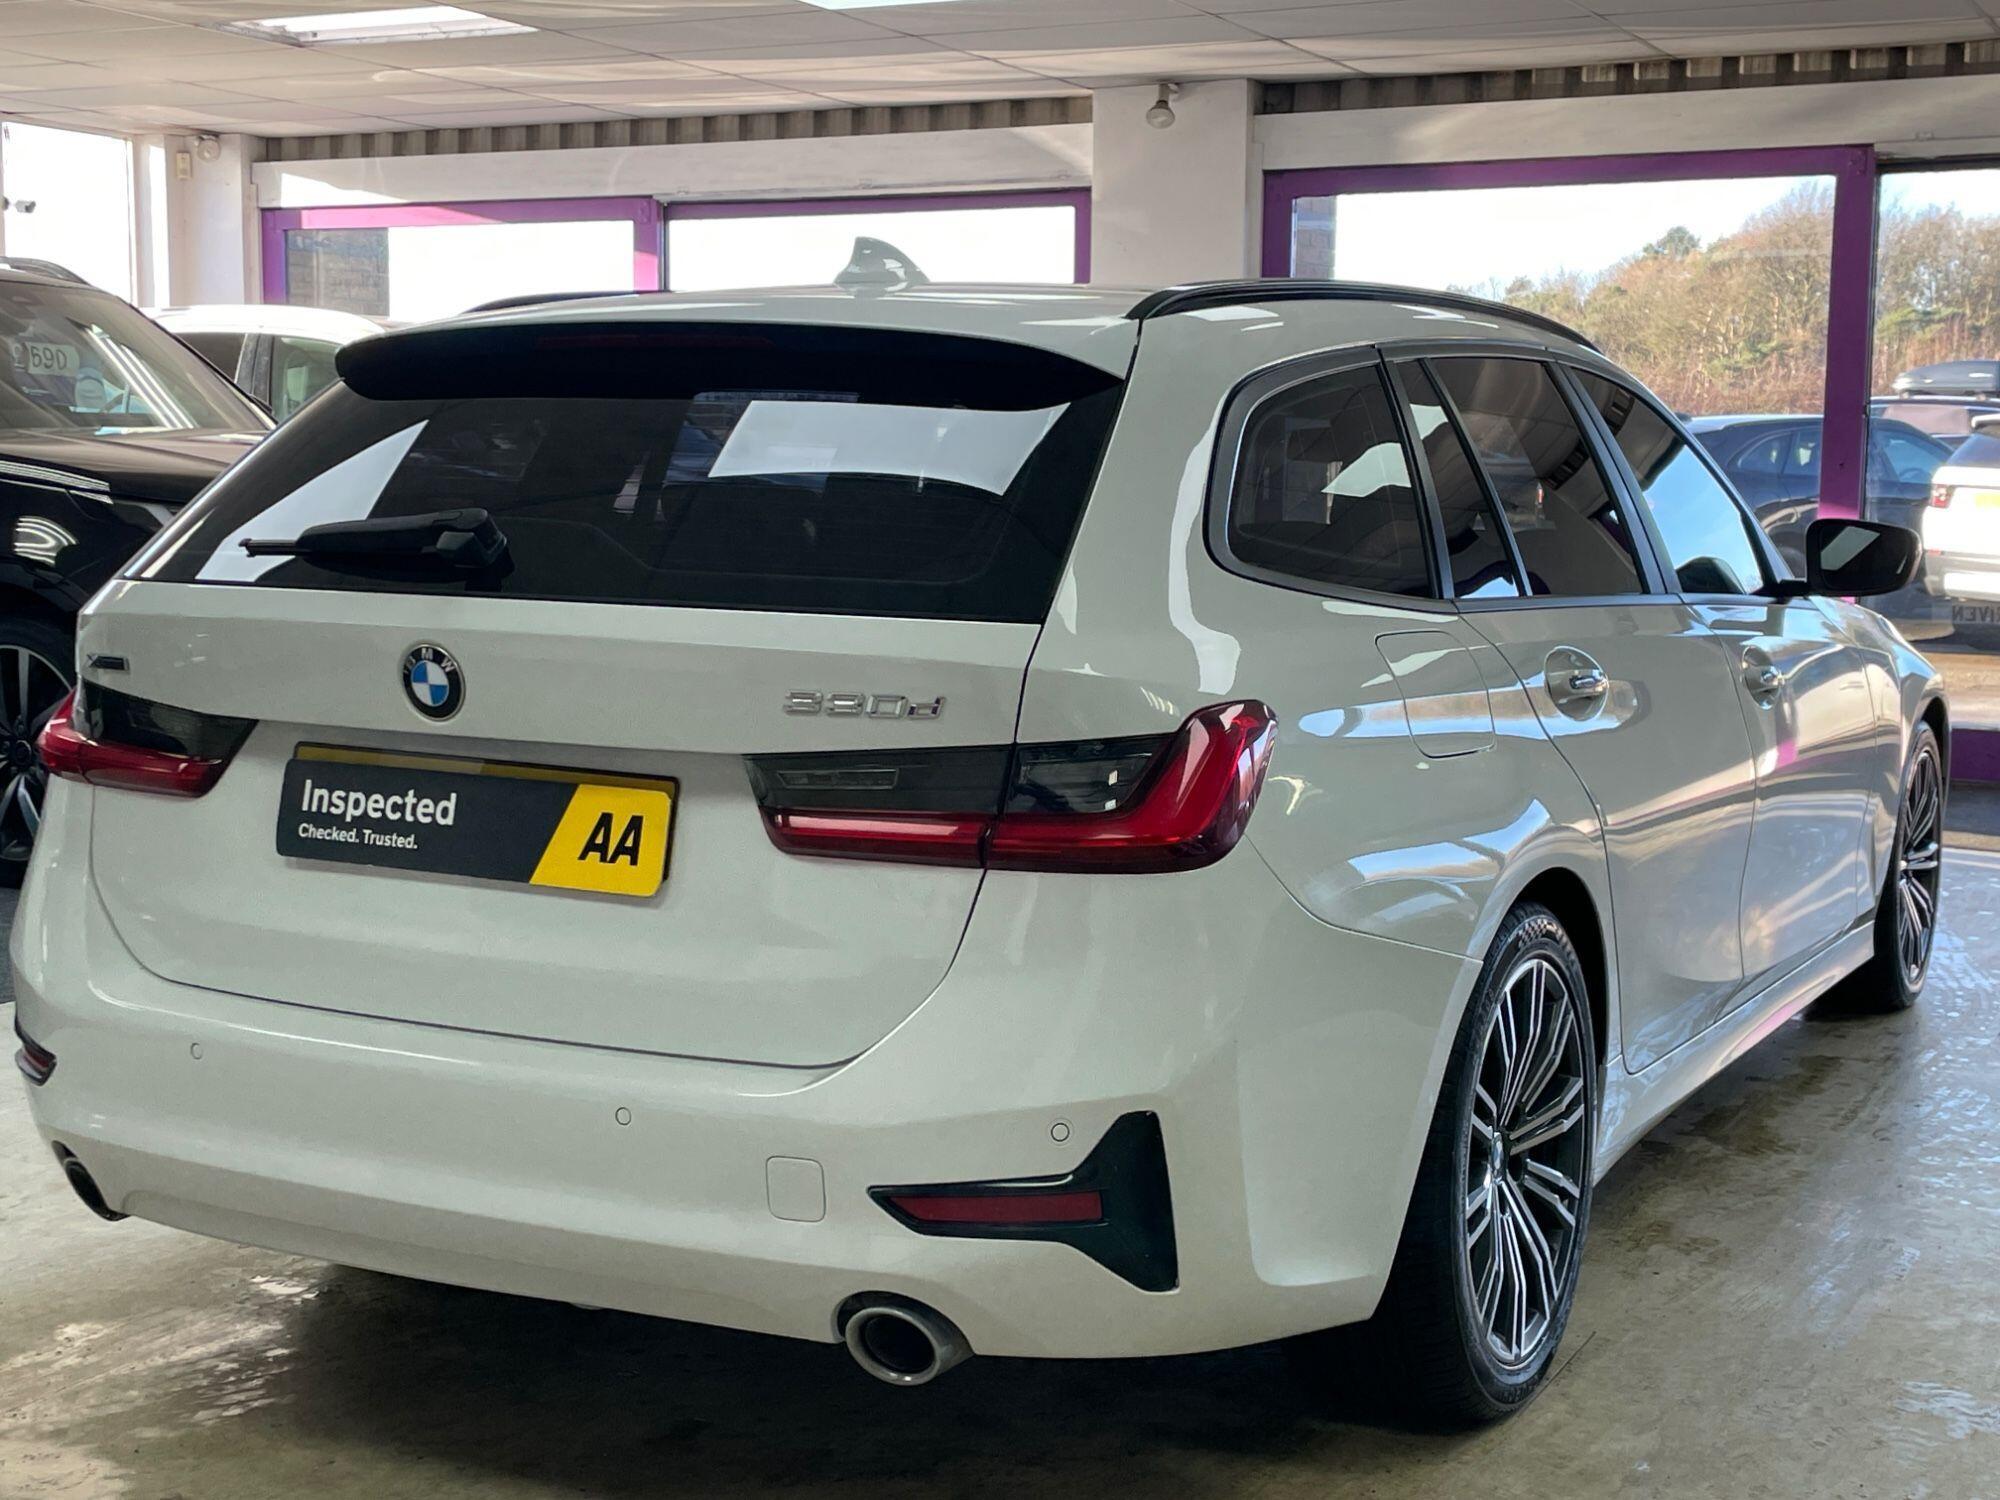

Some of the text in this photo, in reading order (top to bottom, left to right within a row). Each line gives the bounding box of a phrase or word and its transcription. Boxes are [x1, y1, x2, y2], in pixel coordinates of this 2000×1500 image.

[783, 689, 946, 720] 330d
[301, 779, 457, 826] Inspected
[298, 822, 418, 849] Checked. Trusted.
[578, 812, 644, 867] AA
